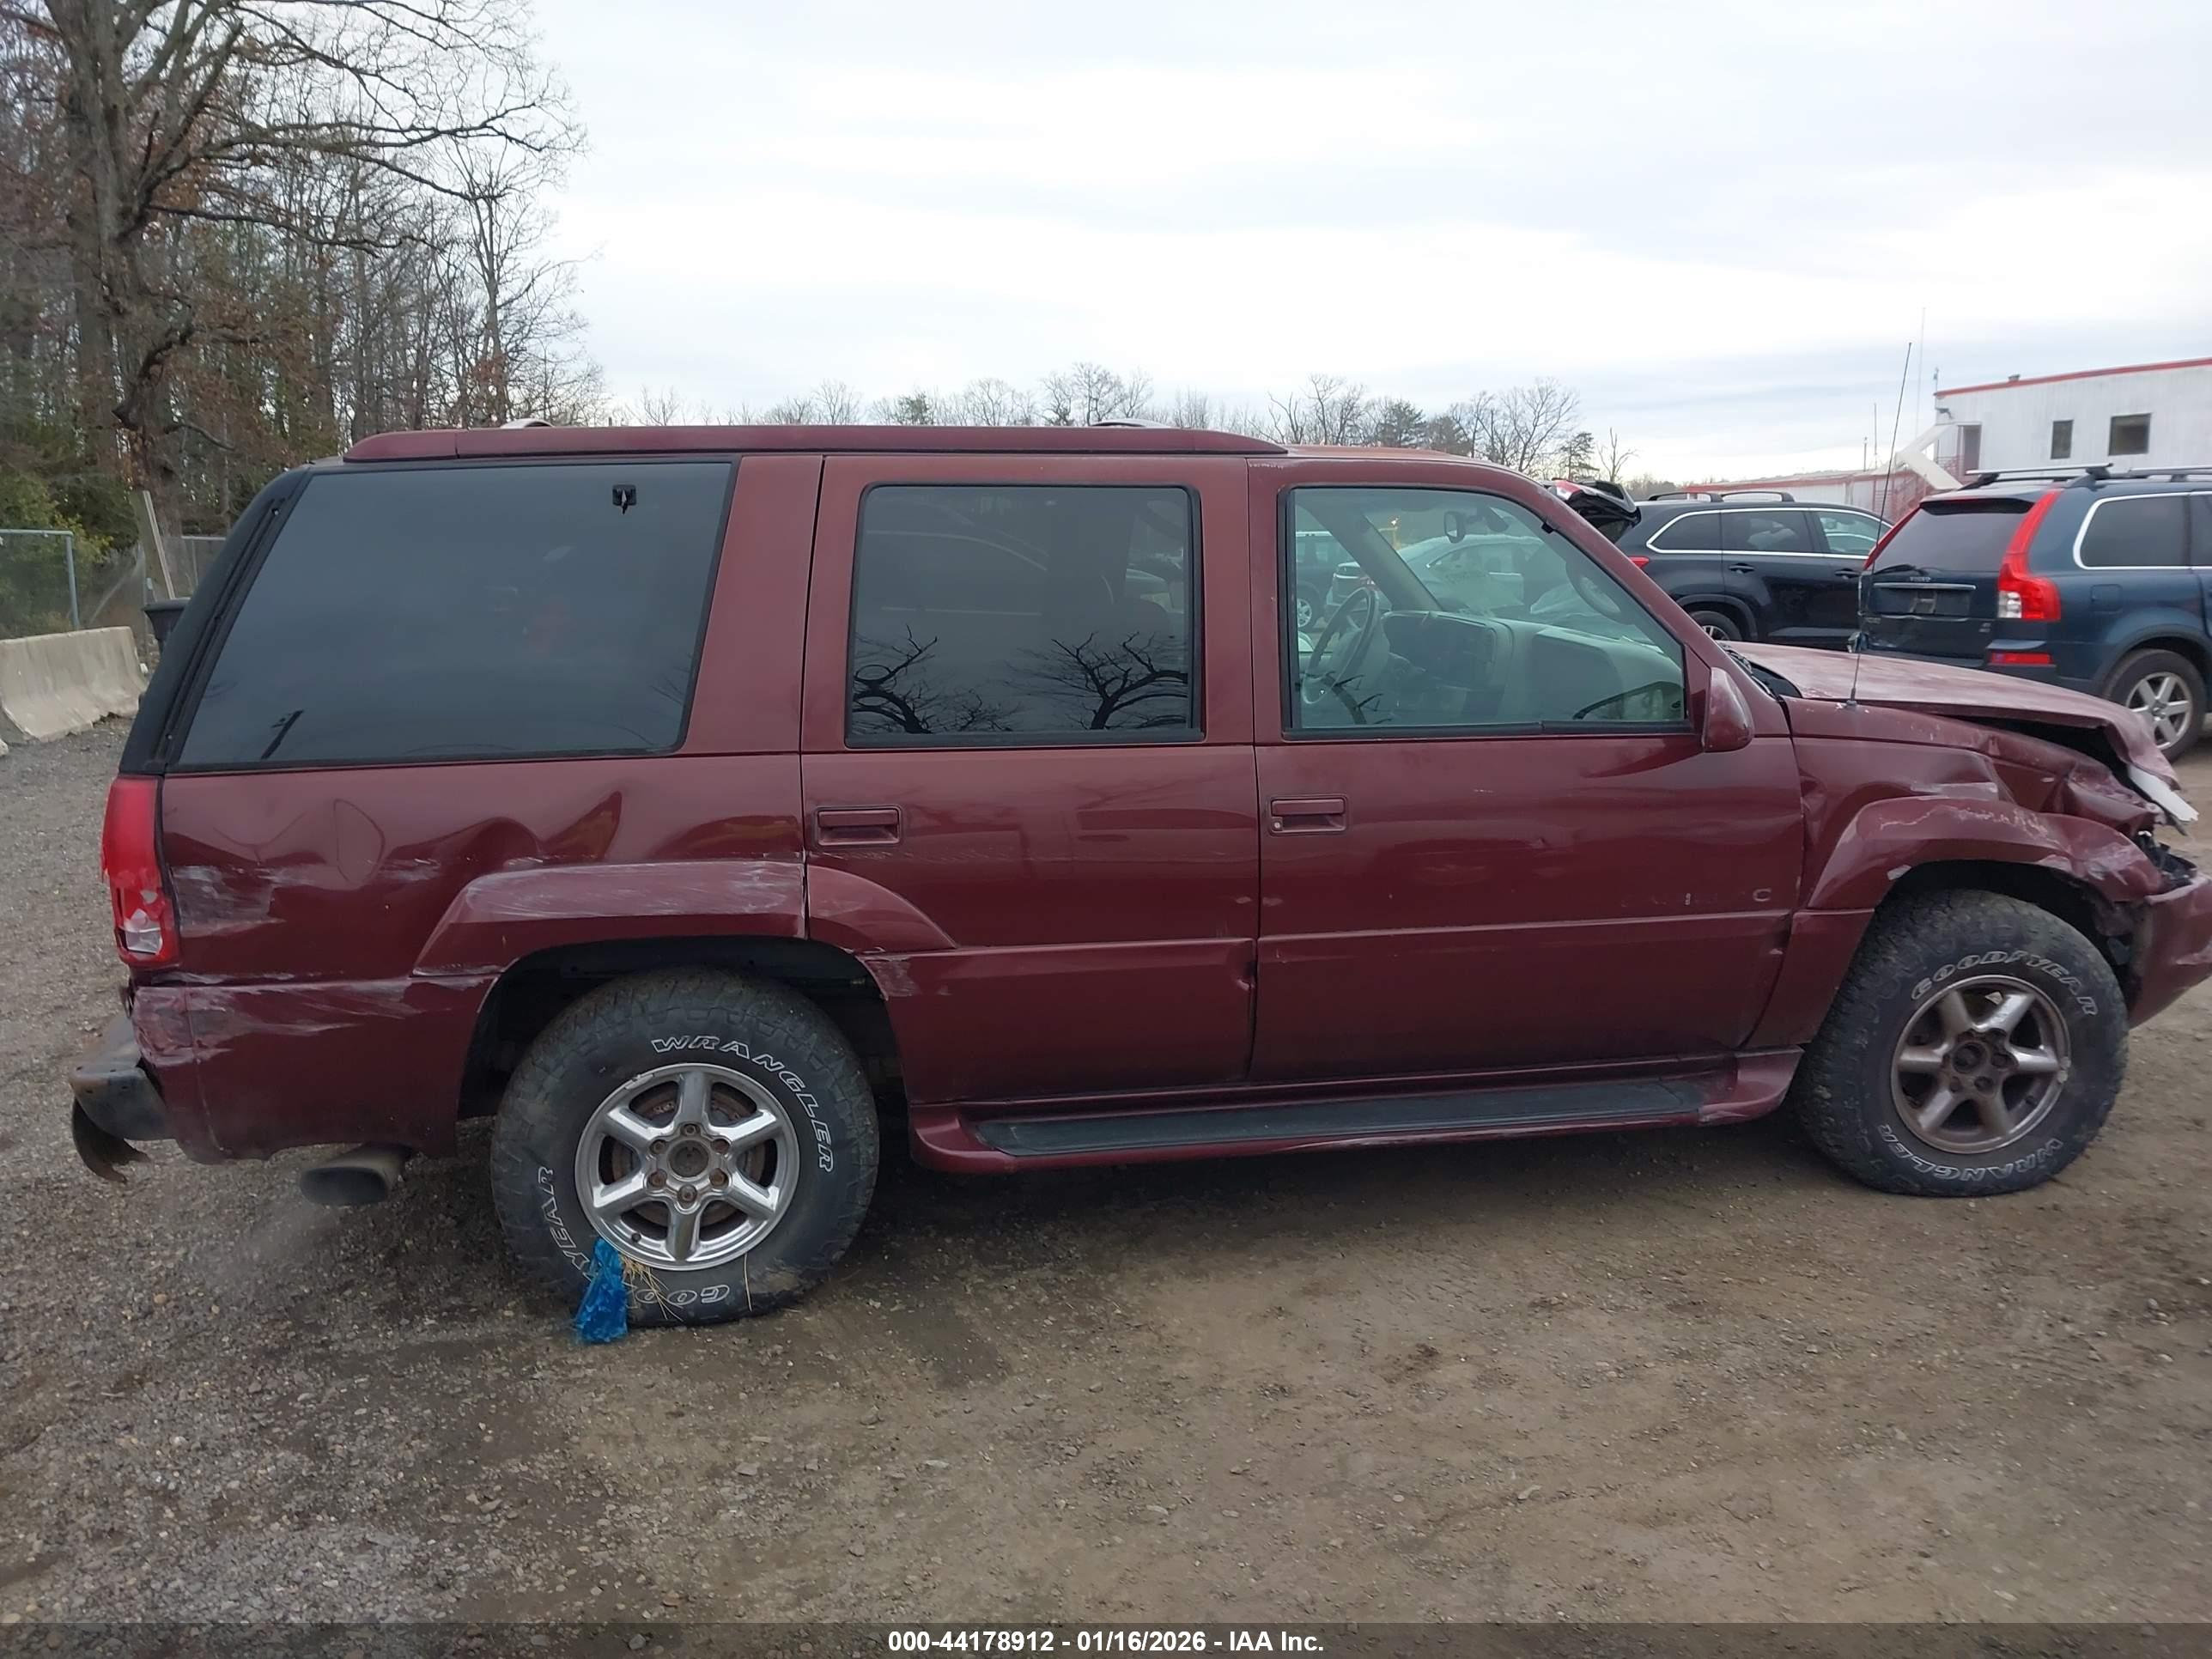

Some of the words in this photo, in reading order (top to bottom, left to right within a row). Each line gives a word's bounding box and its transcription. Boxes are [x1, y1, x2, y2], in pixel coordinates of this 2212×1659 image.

[1911, 951, 2098, 1016] GOODYEAR
[653, 1035, 833, 1173] WRANGLER
[1878, 1124, 2063, 1182] WRANGLER
